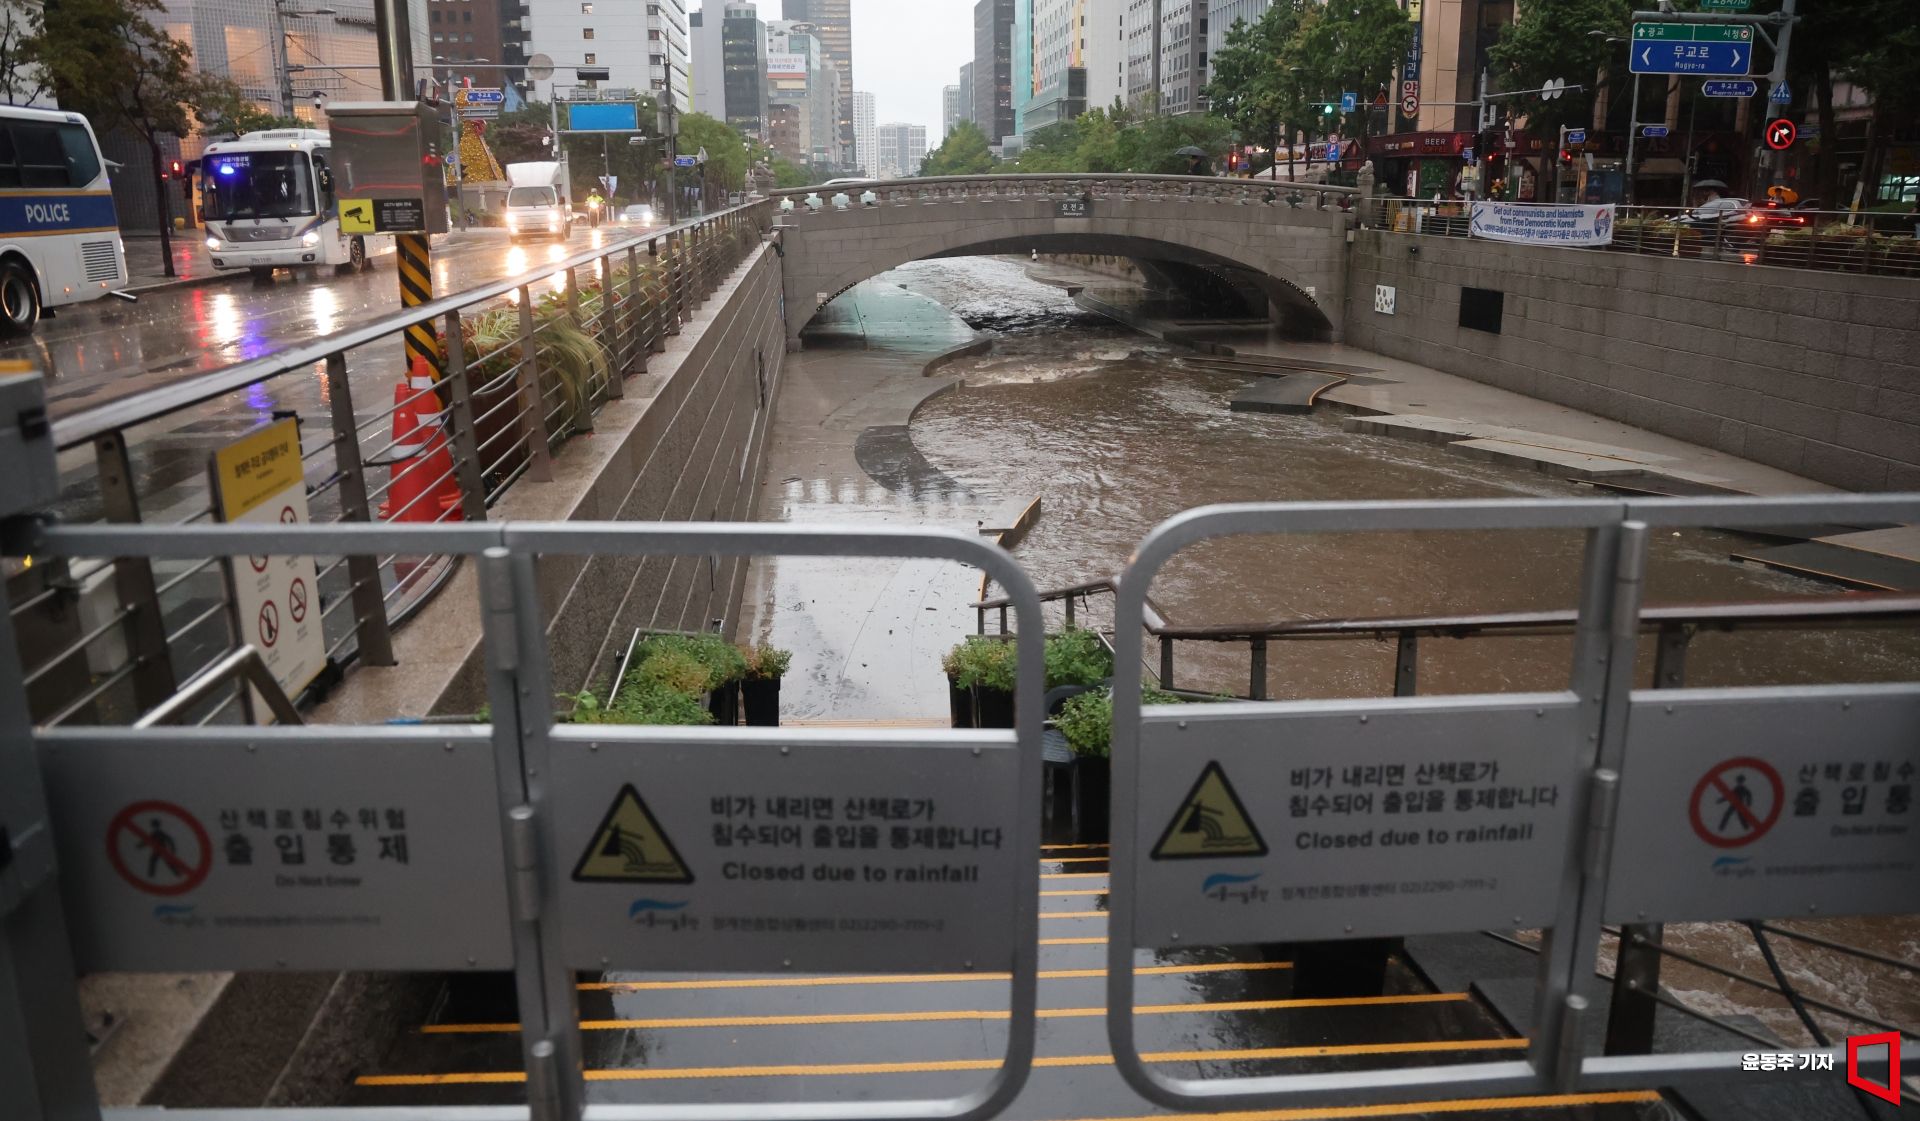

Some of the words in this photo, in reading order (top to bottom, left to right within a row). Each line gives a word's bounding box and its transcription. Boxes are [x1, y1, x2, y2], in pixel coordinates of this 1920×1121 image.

[1648, 27, 1665, 37] 광교
[1723, 29, 1739, 40] 시청
[1673, 46, 1710, 59] 무교로
[1674, 61, 1705, 71] Mugyo-ro
[1425, 138, 1446, 146] BEER
[25, 203, 70, 223] POLICE
[1493, 206, 1502, 215] Get
[1503, 208, 1512, 216] out
[1512, 208, 1545, 218] communists
[1546, 209, 1557, 218] and
[1557, 209, 1584, 218] Islamists
[1500, 217, 1512, 226] from
[1512, 218, 1524, 227] Free
[1524, 218, 1556, 228] Democratic
[1557, 219, 1577, 228] Korea!
[1290, 767, 1333, 789] 비가
[1342, 764, 1405, 788] 내리면
[1415, 761, 1500, 786] 산책로가
[711, 795, 757, 820] 비가
[766, 795, 834, 821] 내리면
[844, 797, 935, 823] 산책로가
[1289, 792, 1374, 818] 침수되어
[1383, 789, 1446, 814] 출입을
[1454, 785, 1558, 812] 통제합니다
[711, 824, 801, 849] 침수되어
[813, 824, 879, 849] 출입을
[890, 825, 1003, 850] 통제합니다
[1295, 828, 1372, 850] Closed
[1380, 828, 1421, 848] due
[1428, 828, 1449, 845] to
[1456, 823, 1533, 844] rainfall
[722, 861, 805, 882] Closed
[812, 864, 855, 883] due
[864, 864, 887, 883] to
[895, 864, 978, 883] rainfall
